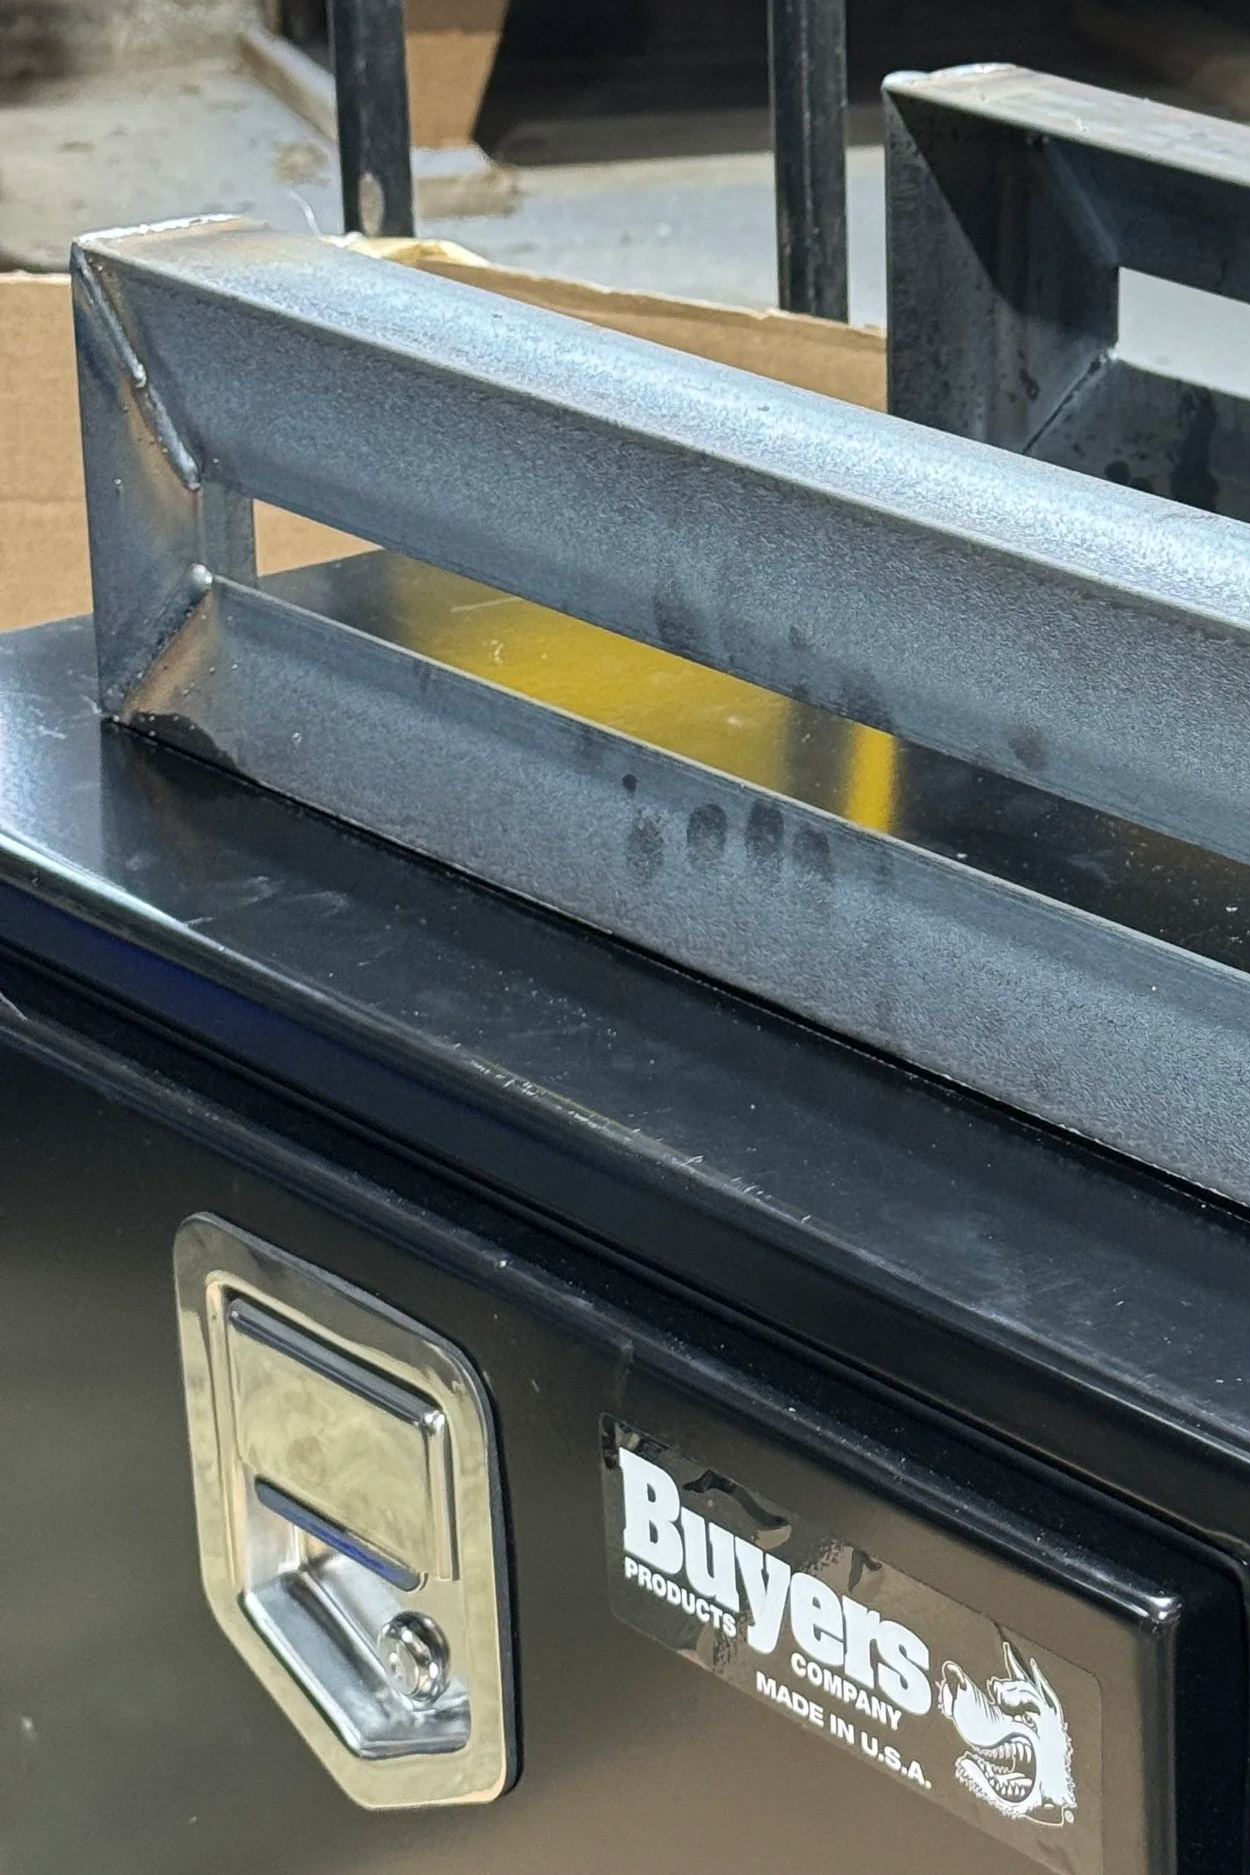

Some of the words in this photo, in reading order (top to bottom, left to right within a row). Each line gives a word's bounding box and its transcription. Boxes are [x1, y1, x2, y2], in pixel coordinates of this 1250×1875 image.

[618, 1446, 932, 1715] Buyers
[623, 1556, 737, 1639] PRODUCTS
[756, 1670, 825, 1728] MADE
[829, 1712, 856, 1746] IN
[860, 1735, 932, 1790] U.S.A.
[791, 1652, 903, 1732] COMPANY
